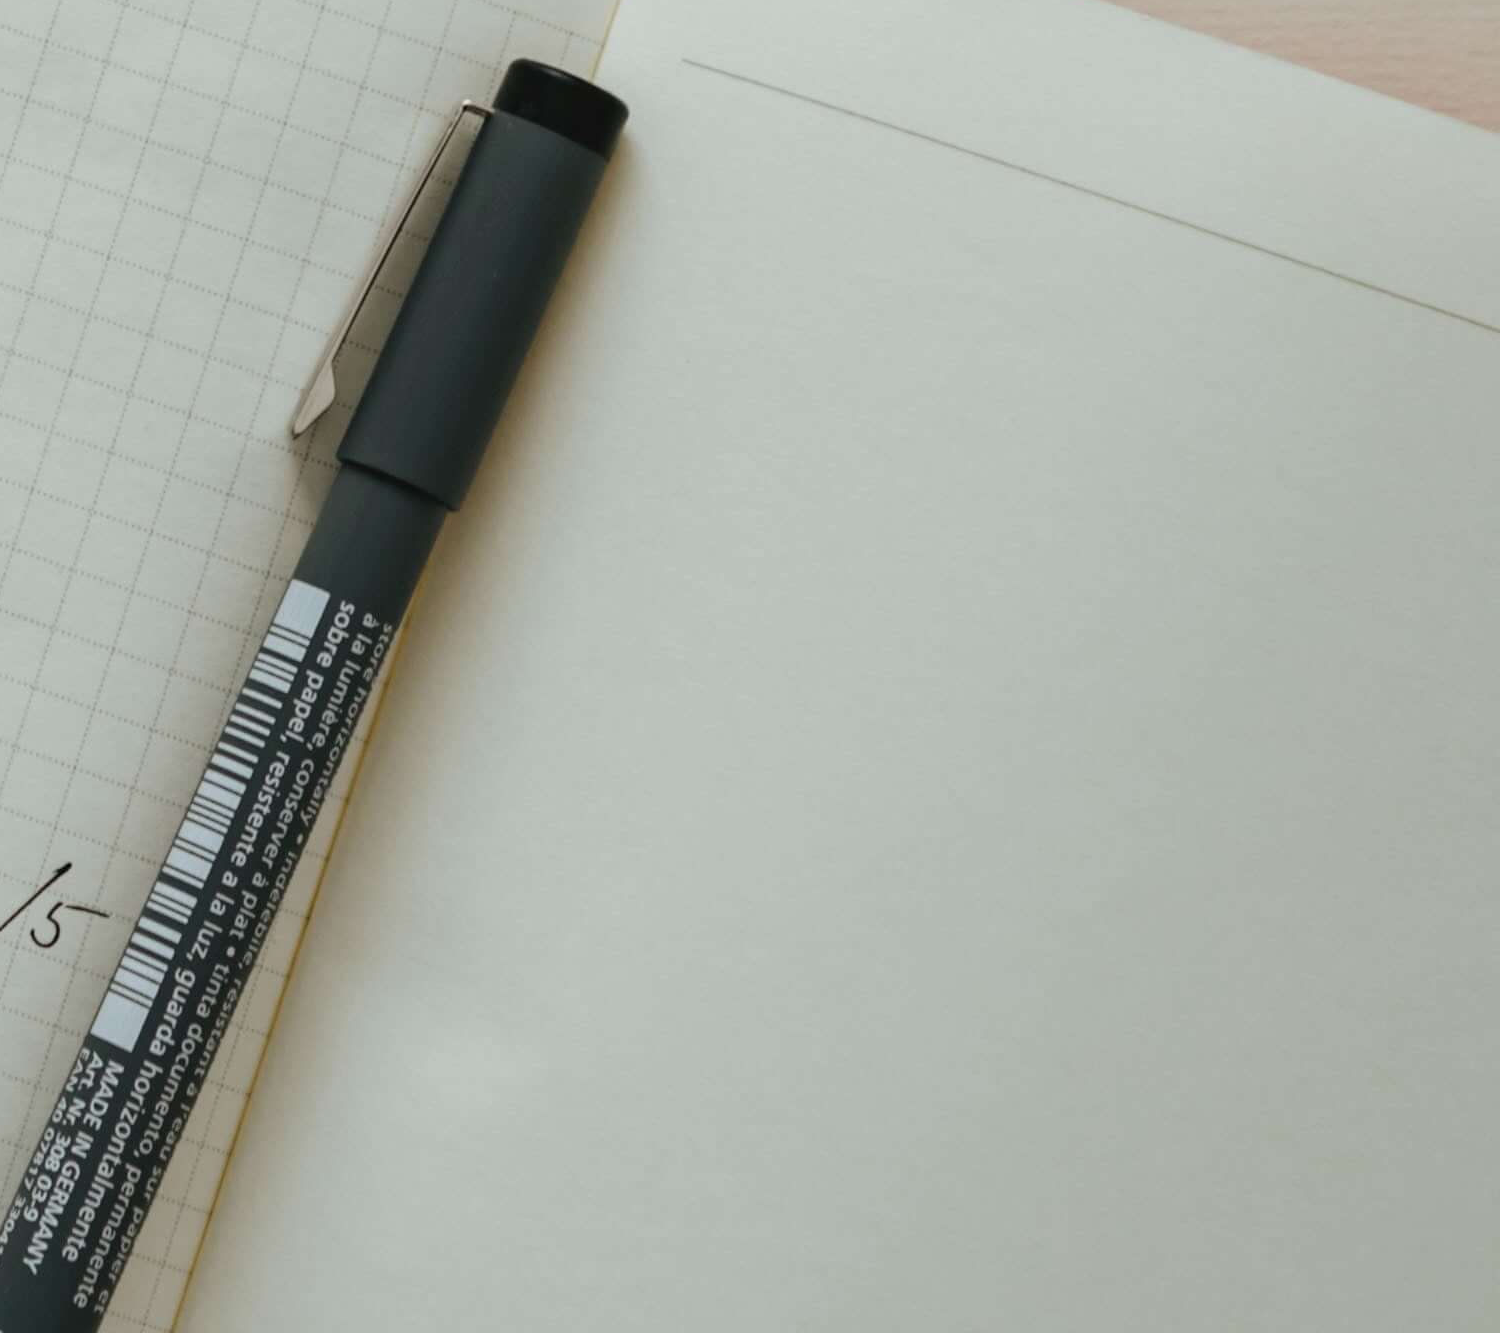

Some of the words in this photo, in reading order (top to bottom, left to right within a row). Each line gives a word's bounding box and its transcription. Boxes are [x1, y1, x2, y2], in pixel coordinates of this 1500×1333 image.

[316, 600, 355, 668] sobre
[350, 633, 373, 655] la
[362, 612, 379, 629] à
[362, 623, 393, 686] store
[279, 669, 325, 743] papel,
[306, 659, 361, 751] lumière,
[299, 686, 372, 827] horizontally
[230, 751, 291, 867] resistente
[261, 758, 315, 869] conserver
[209, 892, 235, 916] la
[221, 870, 239, 888] a
[251, 871, 269, 888] à
[185, 920, 223, 961] luz,
[229, 889, 258, 940] plat
[149, 967, 196, 1056] guarda
[196, 963, 230, 1019] tinta
[65, 1047, 91, 1092] EAN
[77, 1051, 104, 1091] Art.
[82, 1059, 125, 1131] MADE
[133, 1023, 204, 1158] documento,
[62, 1097, 86, 1126] Nr.
[44, 1132, 72, 1172] 308
[61, 1060, 164, 1262] horizontalmente
[70, 1131, 94, 1159] IN
[23, 1174, 53, 1222] 03-9
[144, 1165, 162, 1202] sur
[22, 1160, 81, 1275] GERMANY
[73, 1162, 142, 1309] permanente
[108, 1206, 145, 1284] papier
[93, 1289, 115, 1317] et
